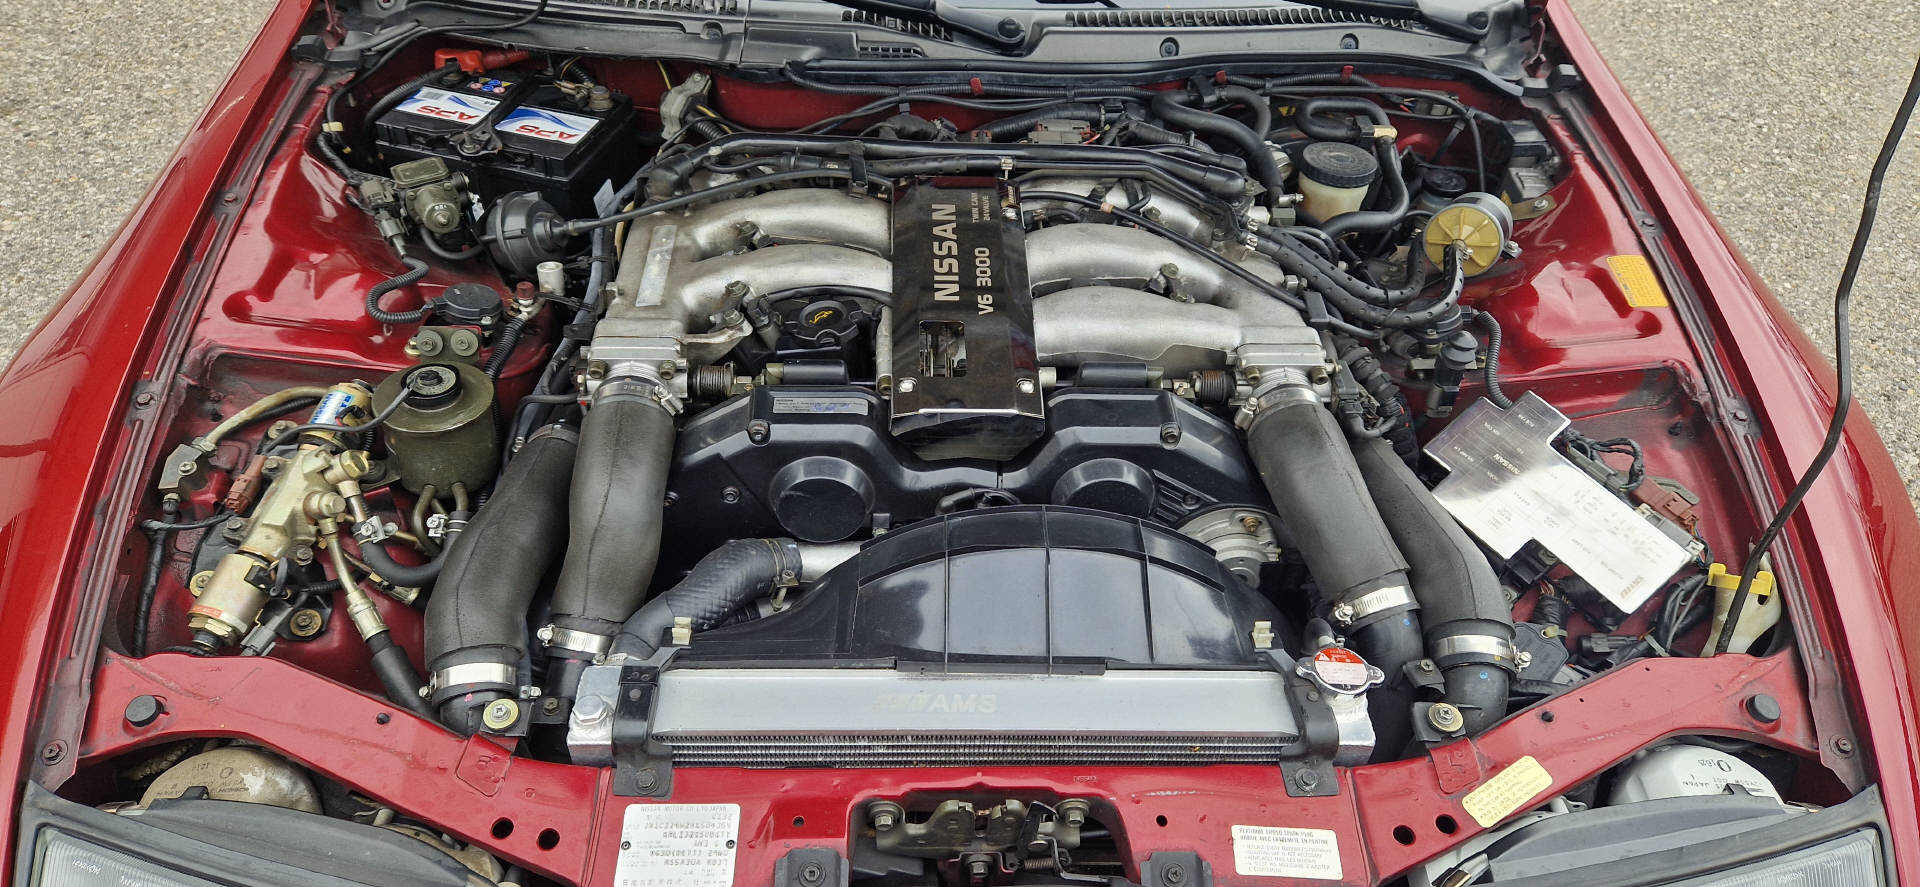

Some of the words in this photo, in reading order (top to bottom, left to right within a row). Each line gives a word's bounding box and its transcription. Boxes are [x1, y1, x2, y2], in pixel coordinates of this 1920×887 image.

[417, 105, 479, 120] APS
[516, 124, 578, 139] APS
[931, 203, 960, 301] NISSAN
[974, 247, 992, 287] 3000
[978, 294, 994, 315] V6
[1492, 453, 1521, 474] NISSAN
